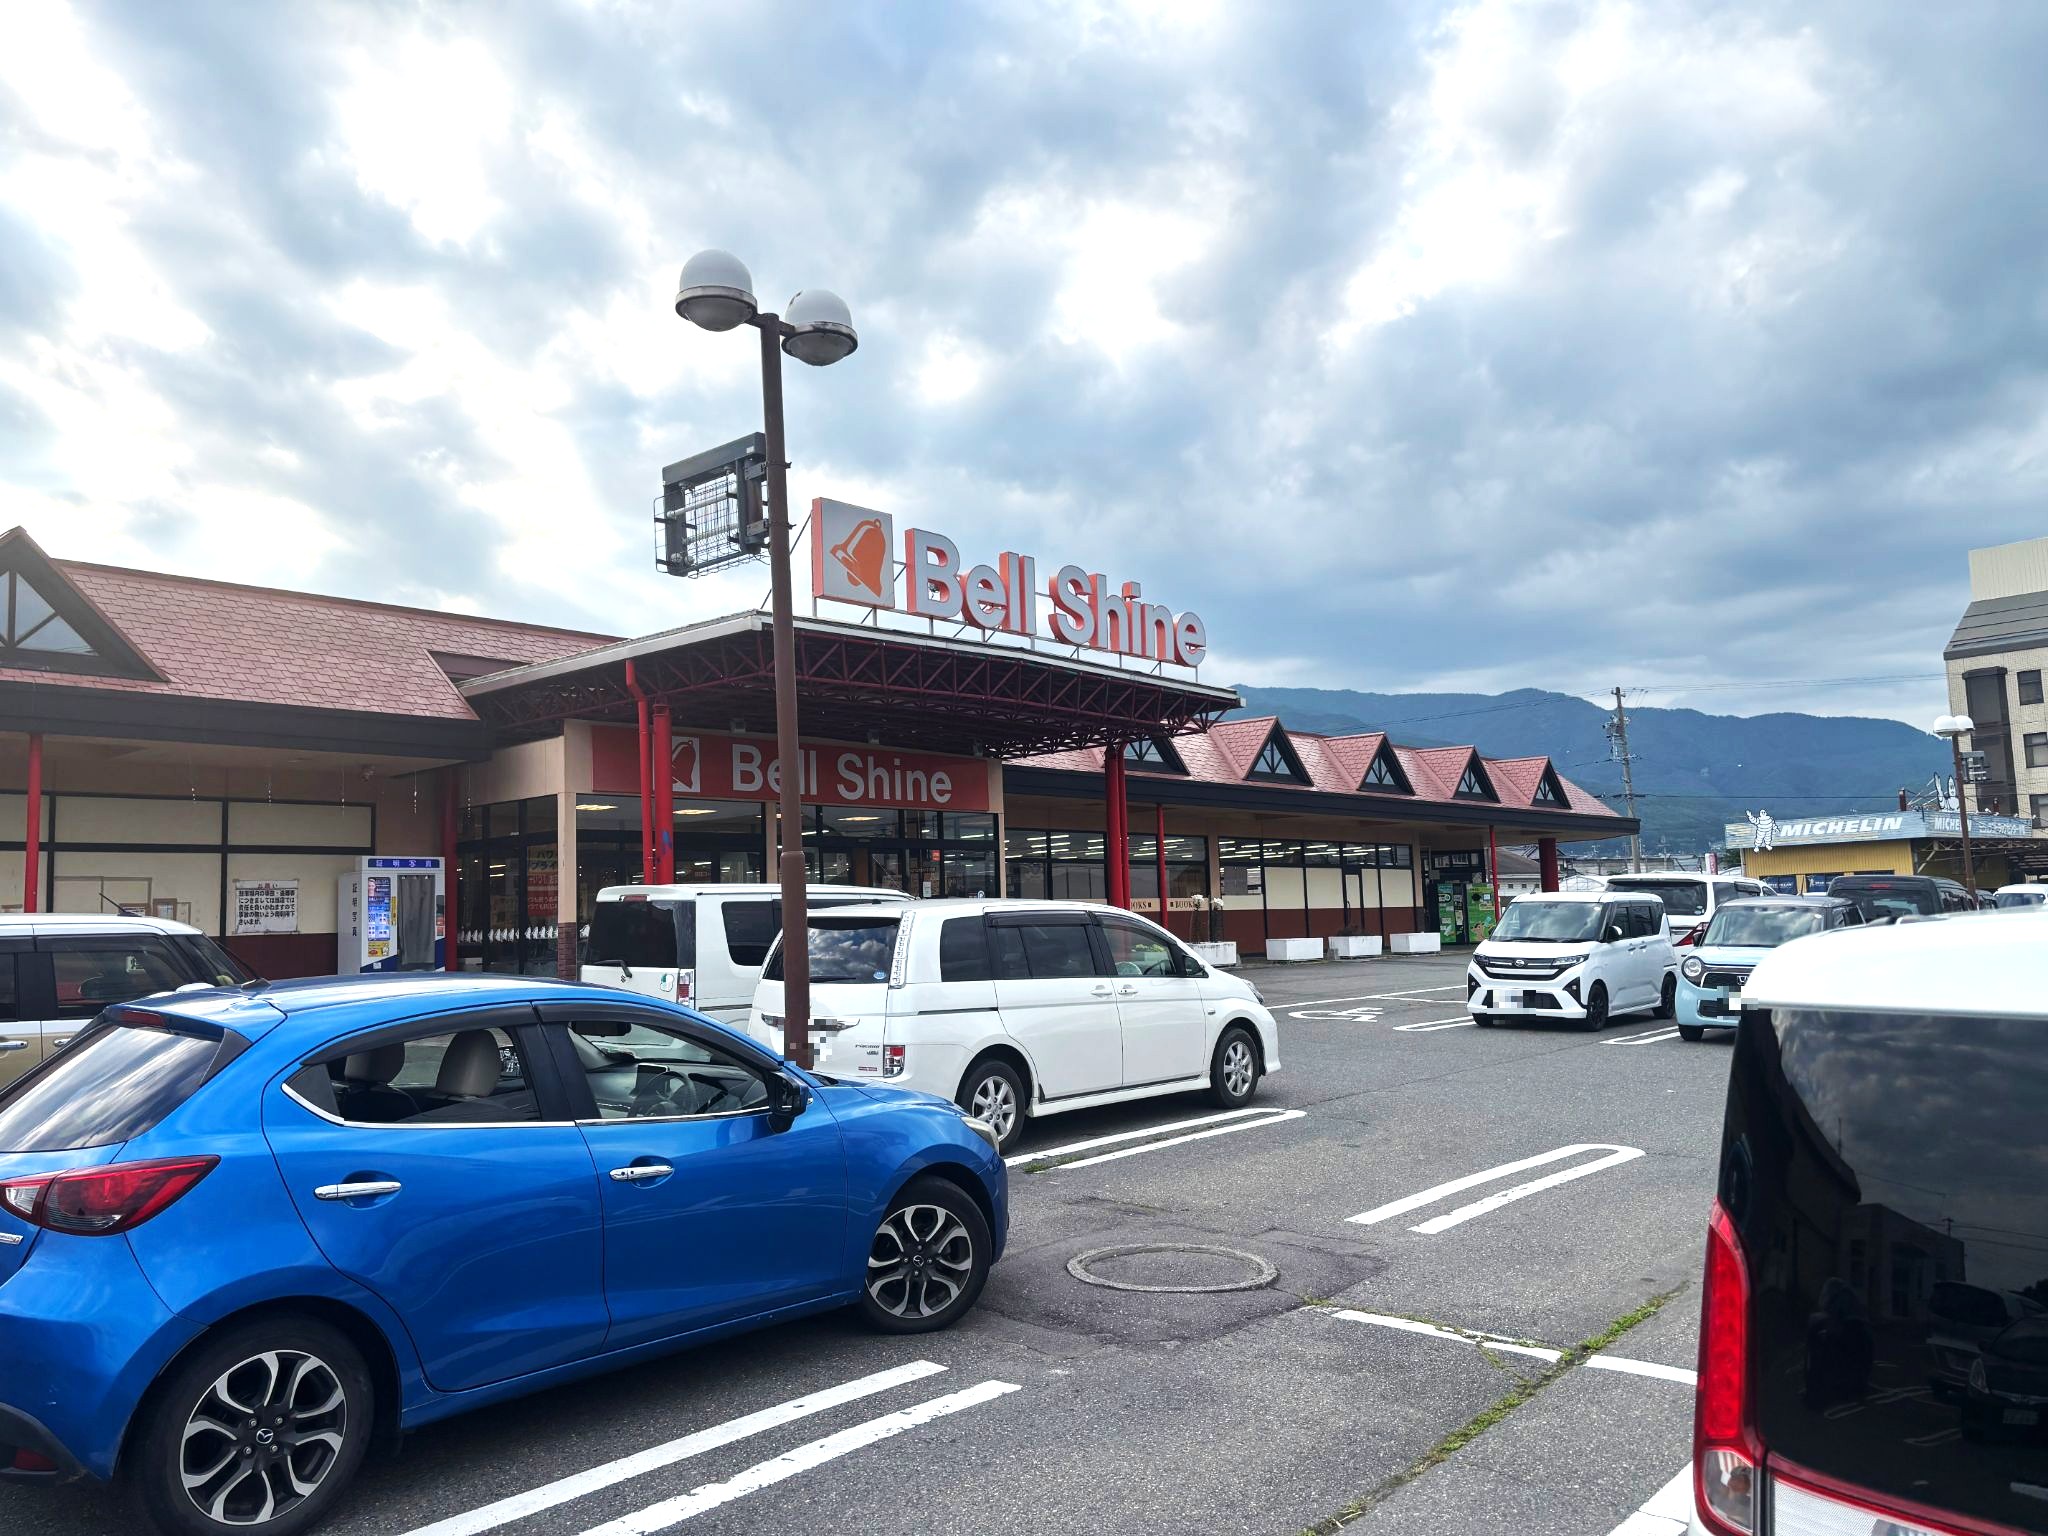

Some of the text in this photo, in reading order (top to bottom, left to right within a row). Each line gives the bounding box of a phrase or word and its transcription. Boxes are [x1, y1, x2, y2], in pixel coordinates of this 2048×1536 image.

[905, 527, 1206, 667] Bell Shine
[732, 743, 953, 804] Bell Shine
[1780, 816, 1903, 837] MICHELIN
[1934, 817, 1972, 832] MICHEN
[375, 859, 432, 868] 証明写真
